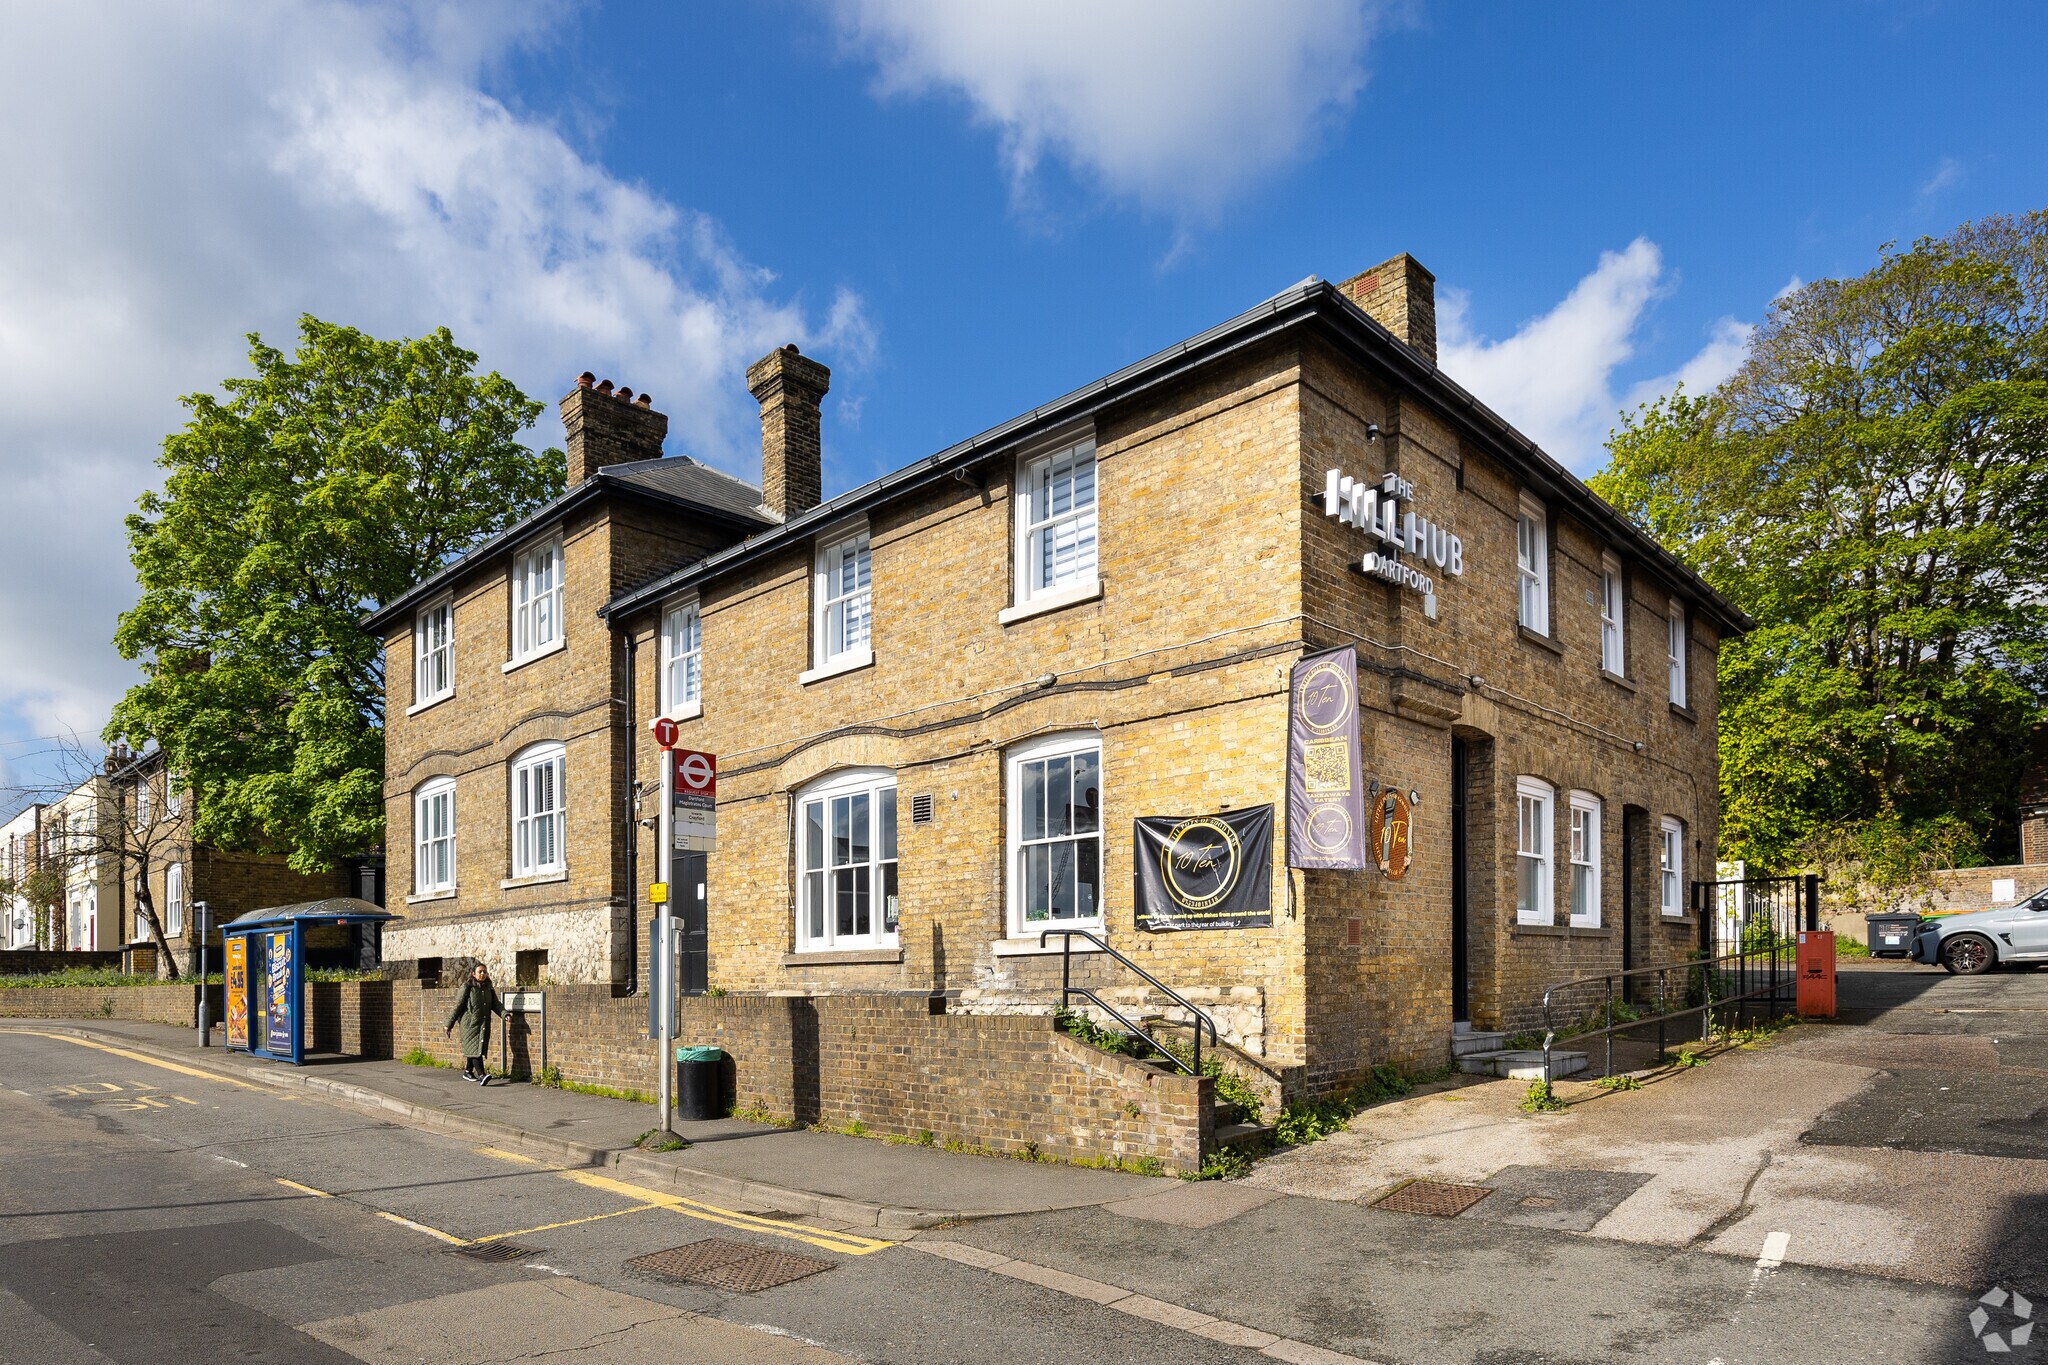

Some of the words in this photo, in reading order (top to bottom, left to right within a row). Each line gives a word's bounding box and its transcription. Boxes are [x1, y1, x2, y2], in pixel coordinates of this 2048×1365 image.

[1382, 472, 1413, 502] THE
[1326, 468, 1405, 549] HILL
[1404, 511, 1463, 576] HUB
[1363, 551, 1434, 595] DARTFORD
[1306, 689, 1318, 706] 10
[1318, 683, 1338, 708] Ten
[1303, 735, 1348, 745] CARIBBEAN
[1391, 820, 1407, 849] Ten
[1175, 851, 1194, 870] 10
[1193, 843, 1223, 873] Ten
[1215, 920, 1235, 928] building
